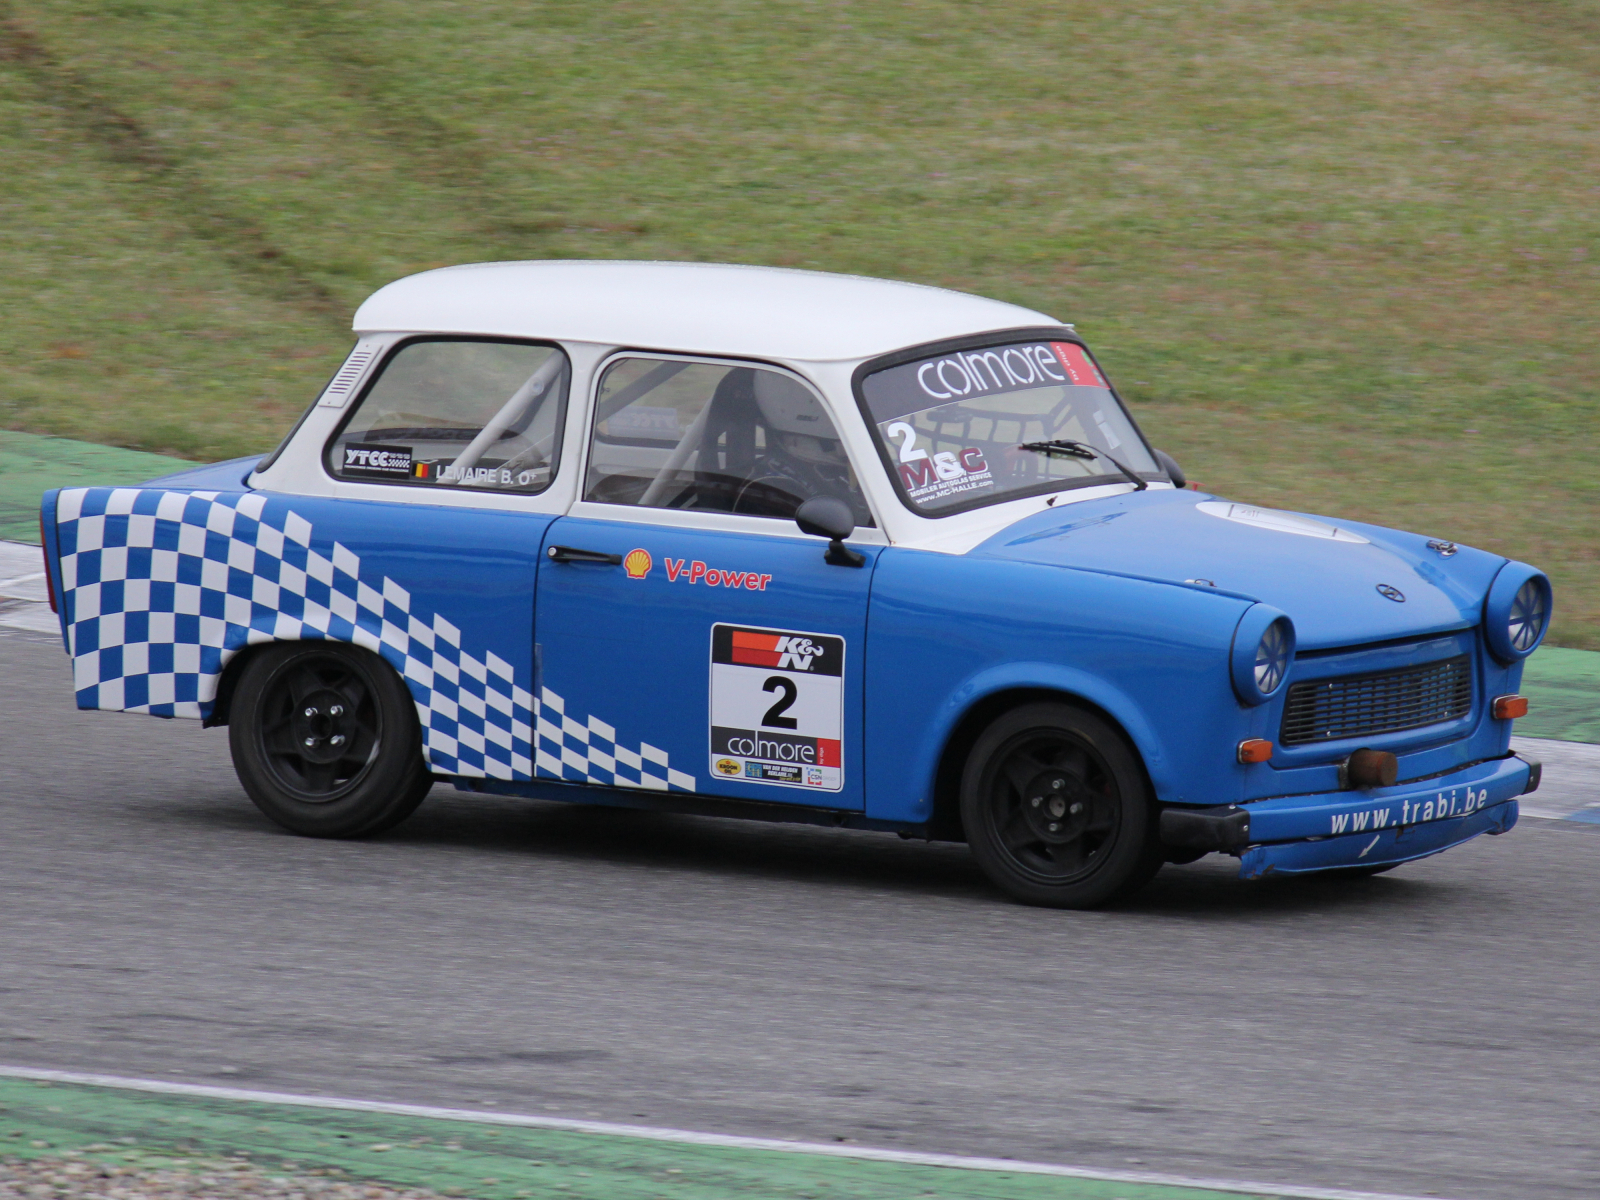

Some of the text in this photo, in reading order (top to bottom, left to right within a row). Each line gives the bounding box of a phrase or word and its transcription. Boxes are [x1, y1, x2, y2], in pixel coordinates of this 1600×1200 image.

[917, 345, 1066, 399] colmore
[345, 449, 390, 467] YTCC
[887, 421, 928, 463] 2
[436, 465, 497, 483] LEMAIRE
[501, 471, 514, 484] B.
[898, 447, 988, 491] M&C
[909, 471, 993, 498] MOBILER AUTOGLAS SERVICE
[915, 480, 994, 504] www.MC-HALLE.com
[664, 557, 772, 591] V-Power
[774, 636, 824, 671] K&N
[761, 675, 798, 730] 2
[727, 730, 815, 763] colmore
[1331, 786, 1488, 834] www.trabi.be
